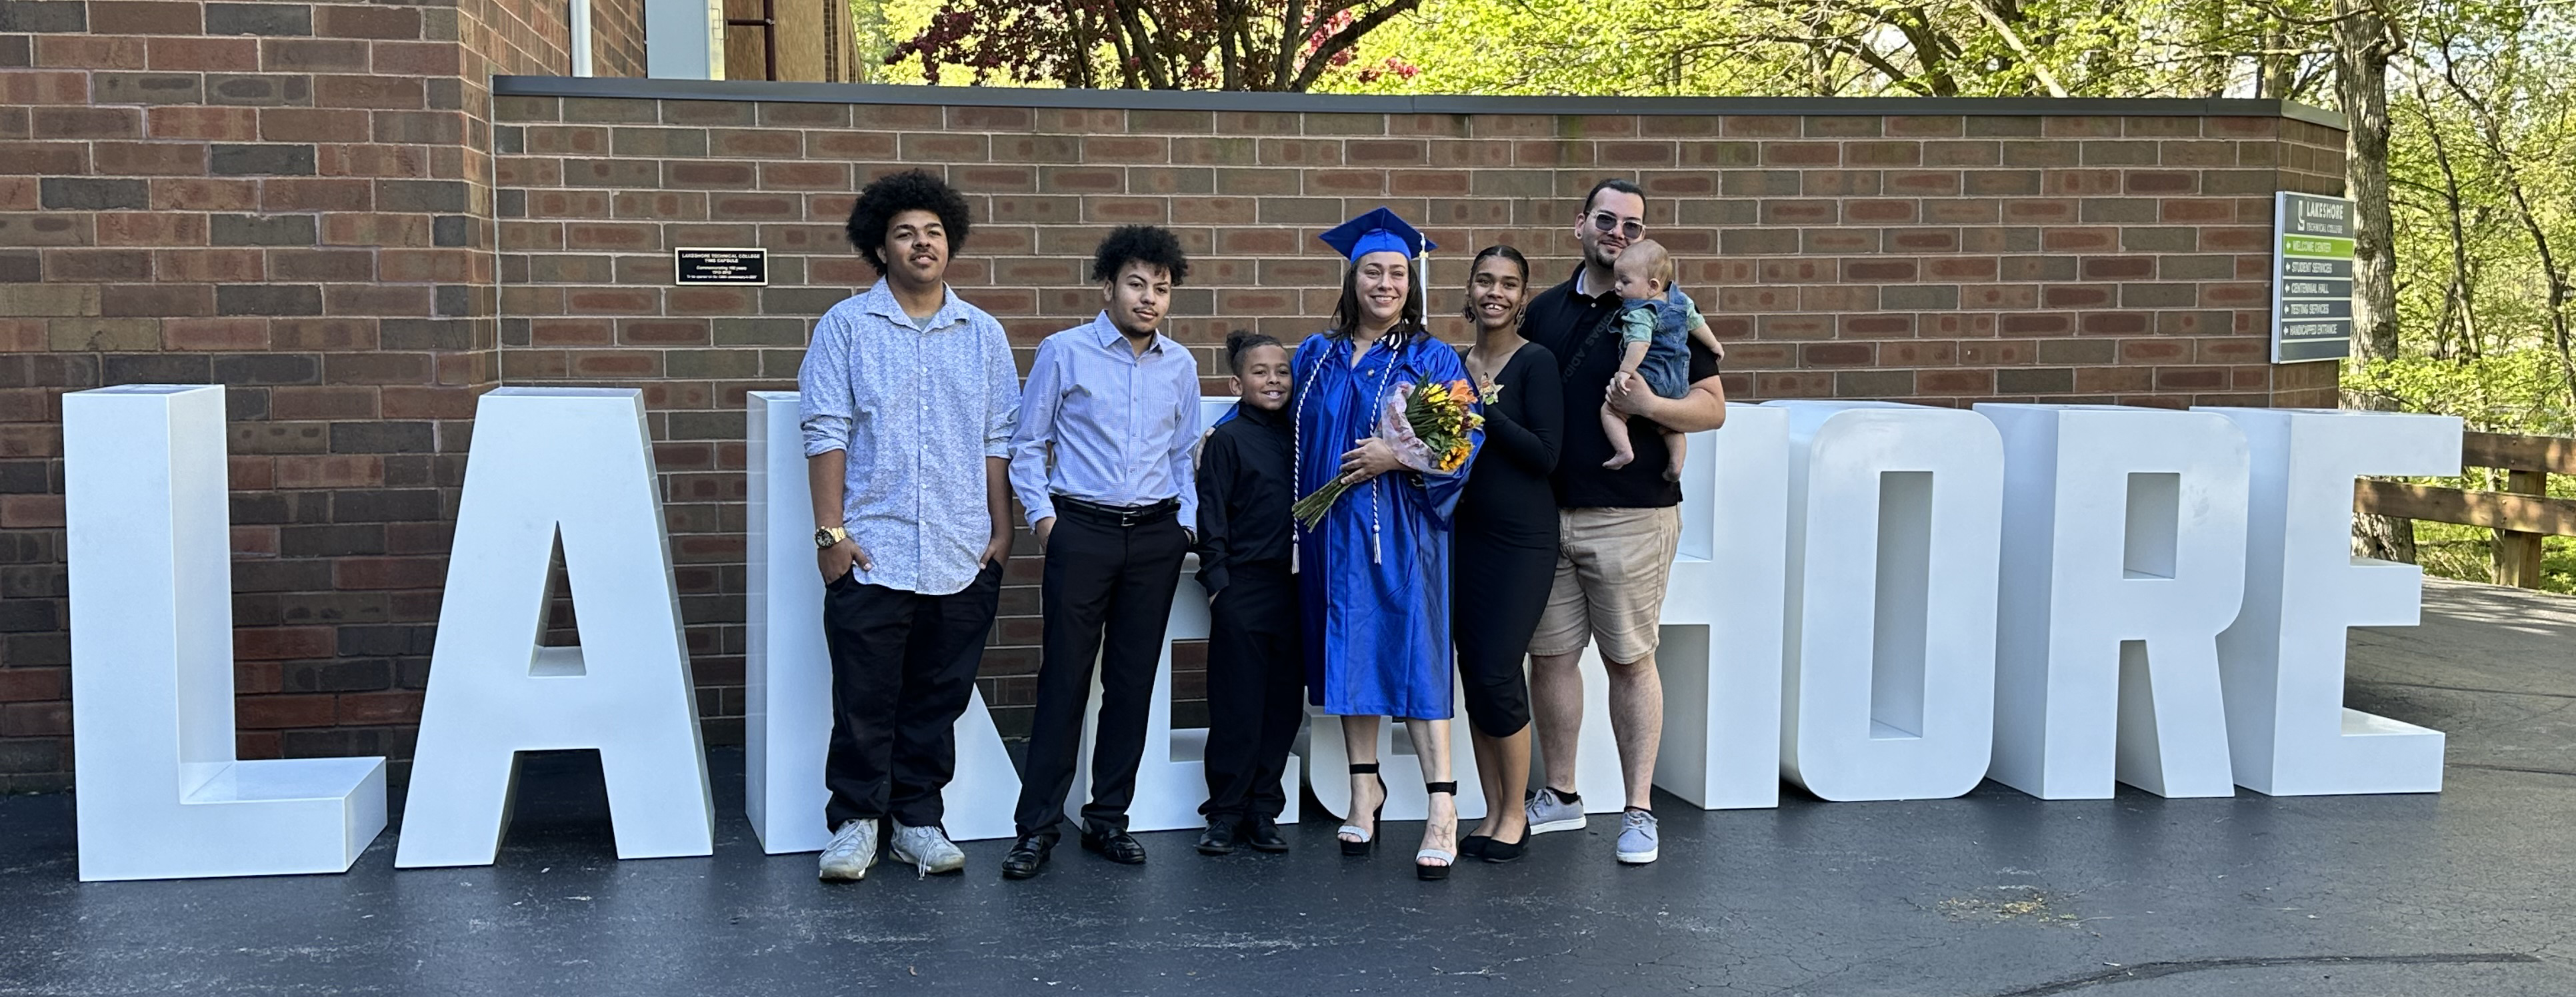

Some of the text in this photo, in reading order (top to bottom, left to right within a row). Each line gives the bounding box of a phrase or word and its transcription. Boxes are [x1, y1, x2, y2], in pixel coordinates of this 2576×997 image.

[2307, 201, 2343, 220] LAKESHORE
[2307, 222, 2343, 234] TECHNICAL COLLEGE
[2293, 241, 2331, 253] WELCOME CENTER
[2292, 261, 2332, 273] STUDENT SERVICES
[2291, 283, 2329, 294] CENTENNIAL HALL
[2291, 304, 2329, 315] TESTING SERVICES
[2290, 324, 2338, 335] HANDICAPPED ENTRANCE
[62, 385, 2463, 882] LAKEHORE
